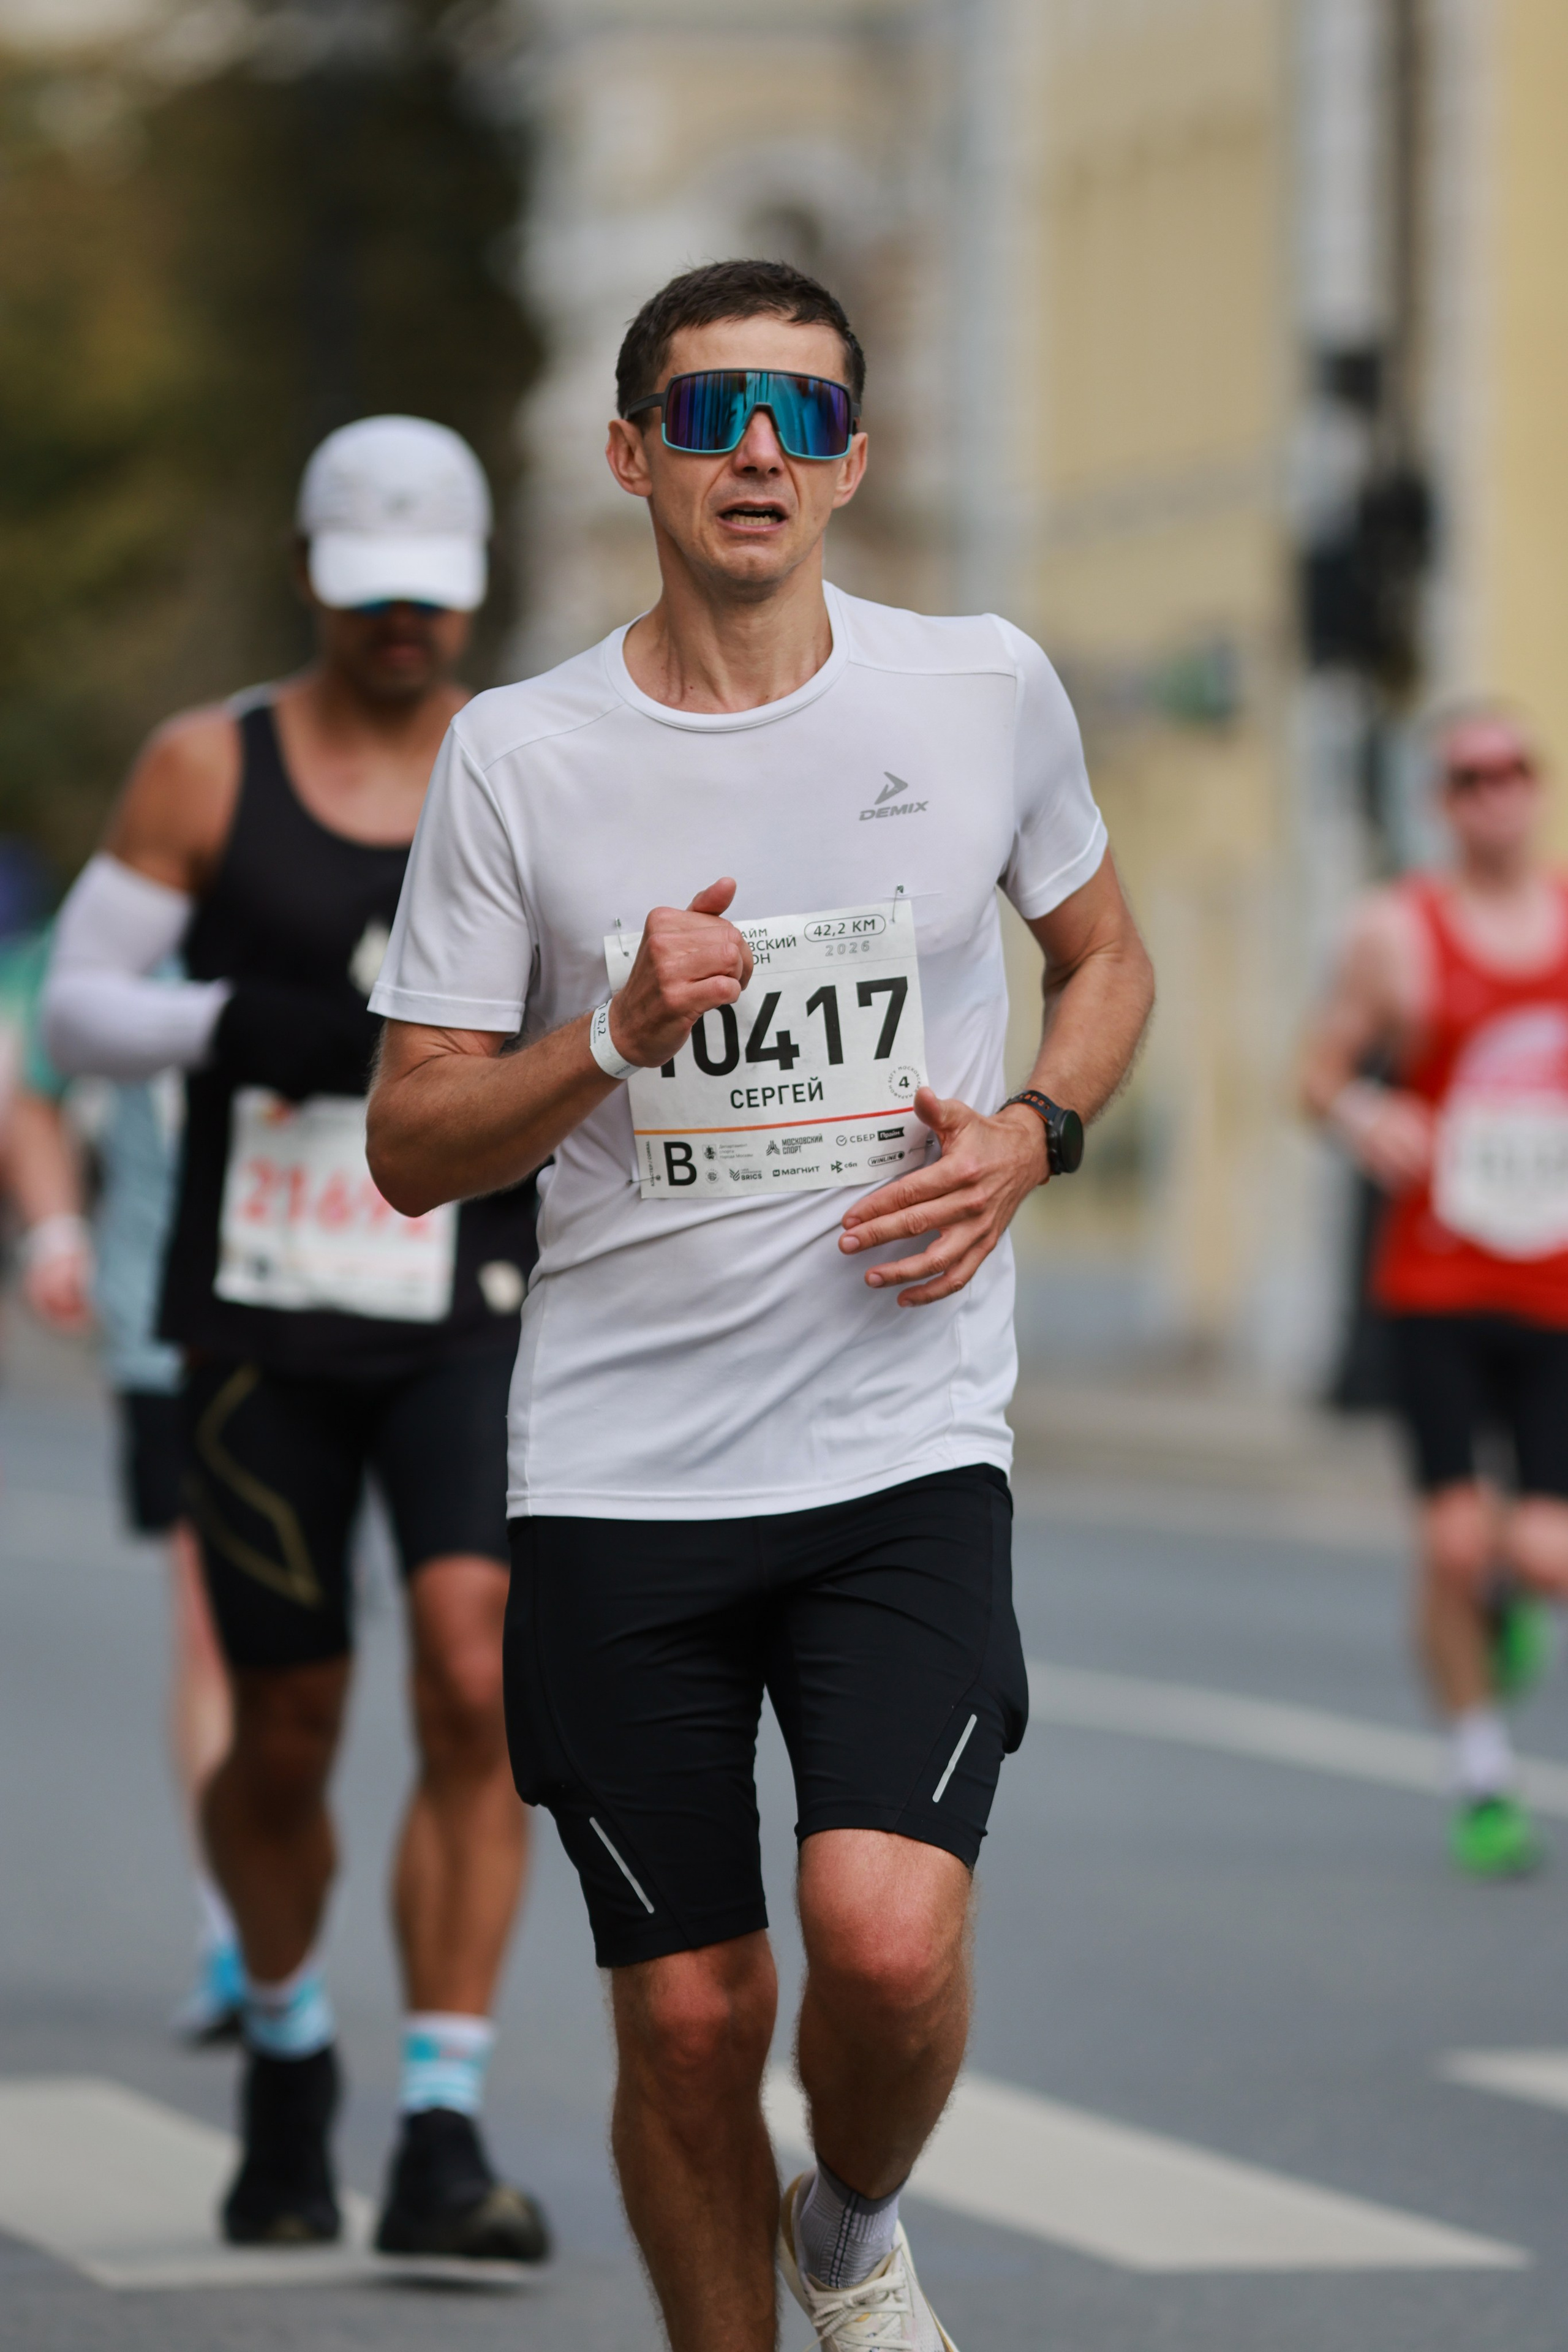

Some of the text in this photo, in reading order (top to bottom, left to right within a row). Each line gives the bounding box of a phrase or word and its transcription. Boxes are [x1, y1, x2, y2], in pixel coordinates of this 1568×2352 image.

[859, 801, 929, 821] DEMIX
[741, 927, 767, 938] АЙМ
[813, 919, 875, 937] 42,2 КМ
[747, 934, 796, 952] ВСКИЙ
[825, 940, 870, 957] 2026
[661, 976, 908, 1078] 0417
[899, 1076, 910, 1088] 4
[730, 1077, 824, 1109] СЕРГЕЙ
[782, 1133, 823, 1147] МОСКОВСКИЙ
[850, 1130, 900, 1143] СБЕР Прайм
[782, 1145, 802, 1155] СПОРТ
[870, 1155, 897, 1165] WINLINE
